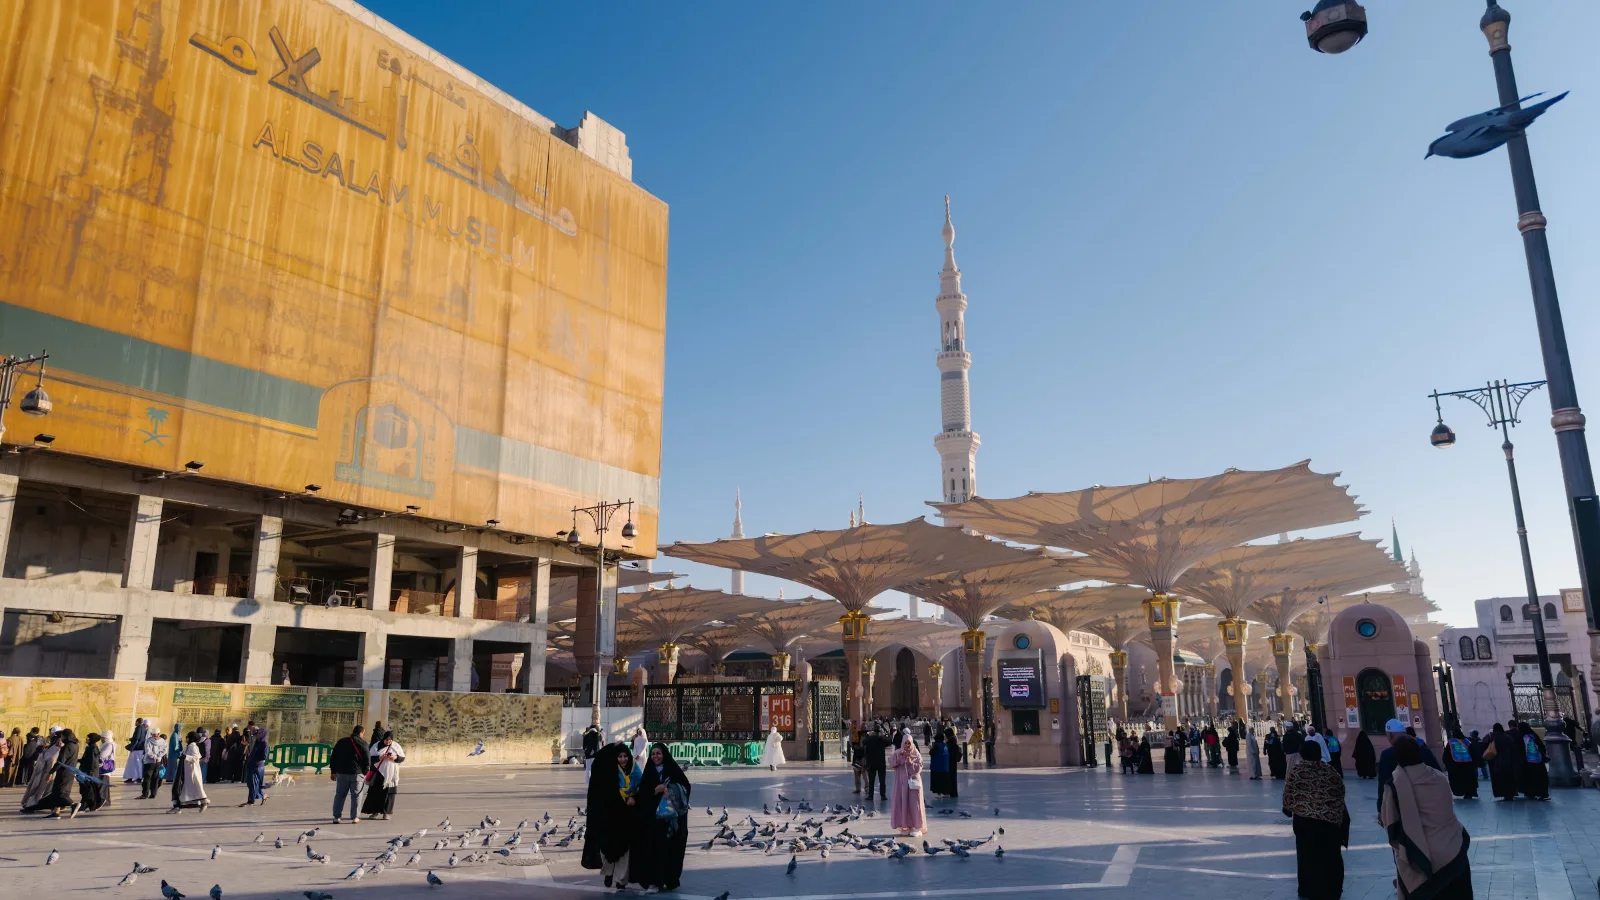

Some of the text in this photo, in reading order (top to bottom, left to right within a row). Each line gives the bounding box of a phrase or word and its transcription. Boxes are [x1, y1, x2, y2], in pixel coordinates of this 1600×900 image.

[188, 25, 409, 151] السلام
[252, 120, 536, 272] ALSALAM MUSEUM
[772, 698, 790, 712] ٣١٦
[772, 714, 792, 727] 316
